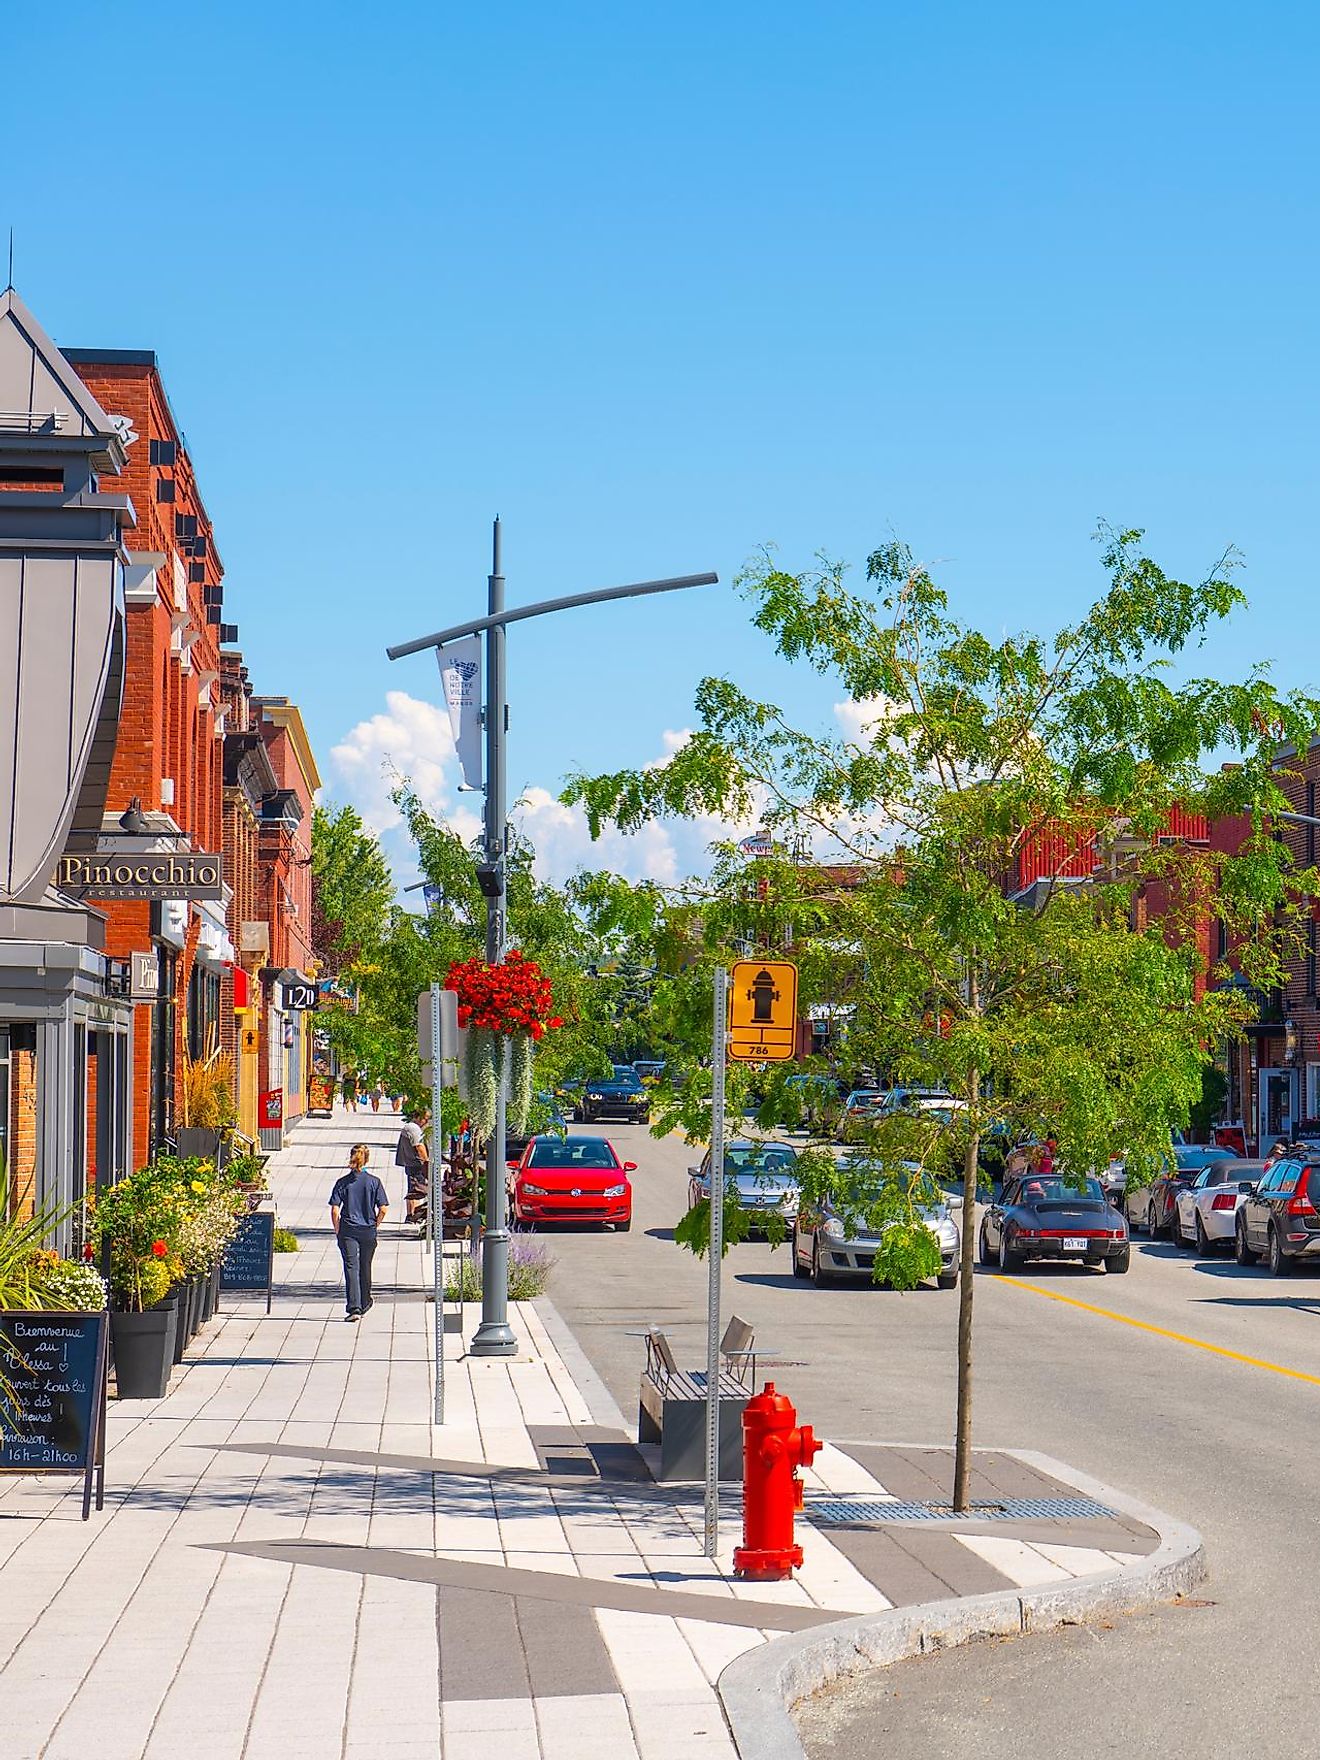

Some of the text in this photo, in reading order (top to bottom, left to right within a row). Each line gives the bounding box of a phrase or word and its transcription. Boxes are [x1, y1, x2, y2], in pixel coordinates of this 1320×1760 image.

[62, 857, 217, 885] Pinocchio
[288, 986, 315, 1009] L2D
[749, 1047, 769, 1055] 786
[14, 1322, 85, 1338] Bienvenue
[35, 1342, 60, 1352] au
[44, 1379, 71, 1392] tous
[72, 1379, 87, 1393] les
